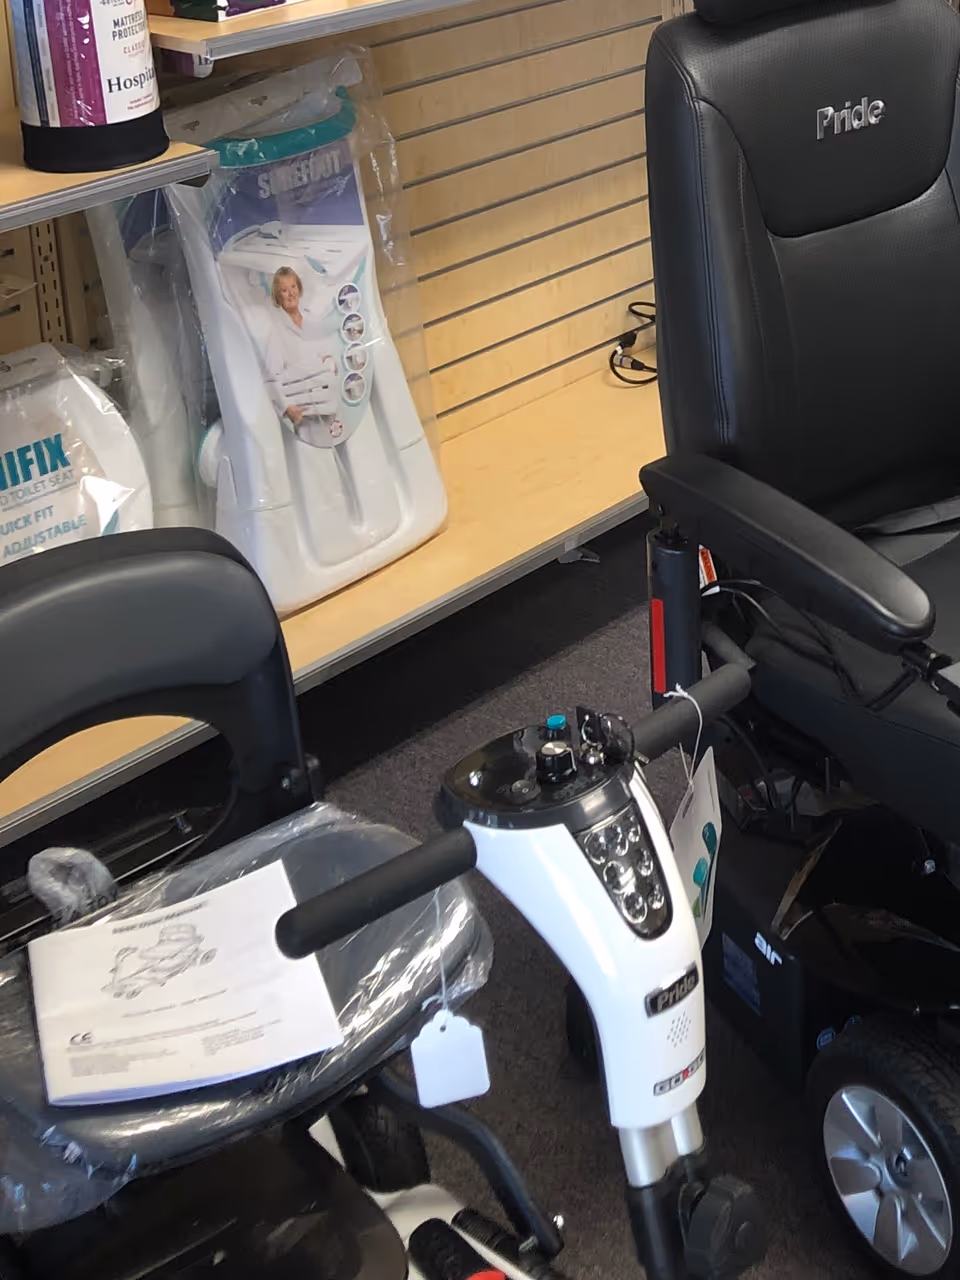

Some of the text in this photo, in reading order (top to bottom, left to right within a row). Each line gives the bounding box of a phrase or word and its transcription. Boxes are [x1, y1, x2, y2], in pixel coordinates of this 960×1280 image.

[816, 96, 886, 141] Pride
[10, 469, 74, 501] TOILET SEAT
[34, 505, 54, 520] FIT
[3, 515, 87, 558] ADJUSTABLE
[656, 975, 696, 1012] Pride
